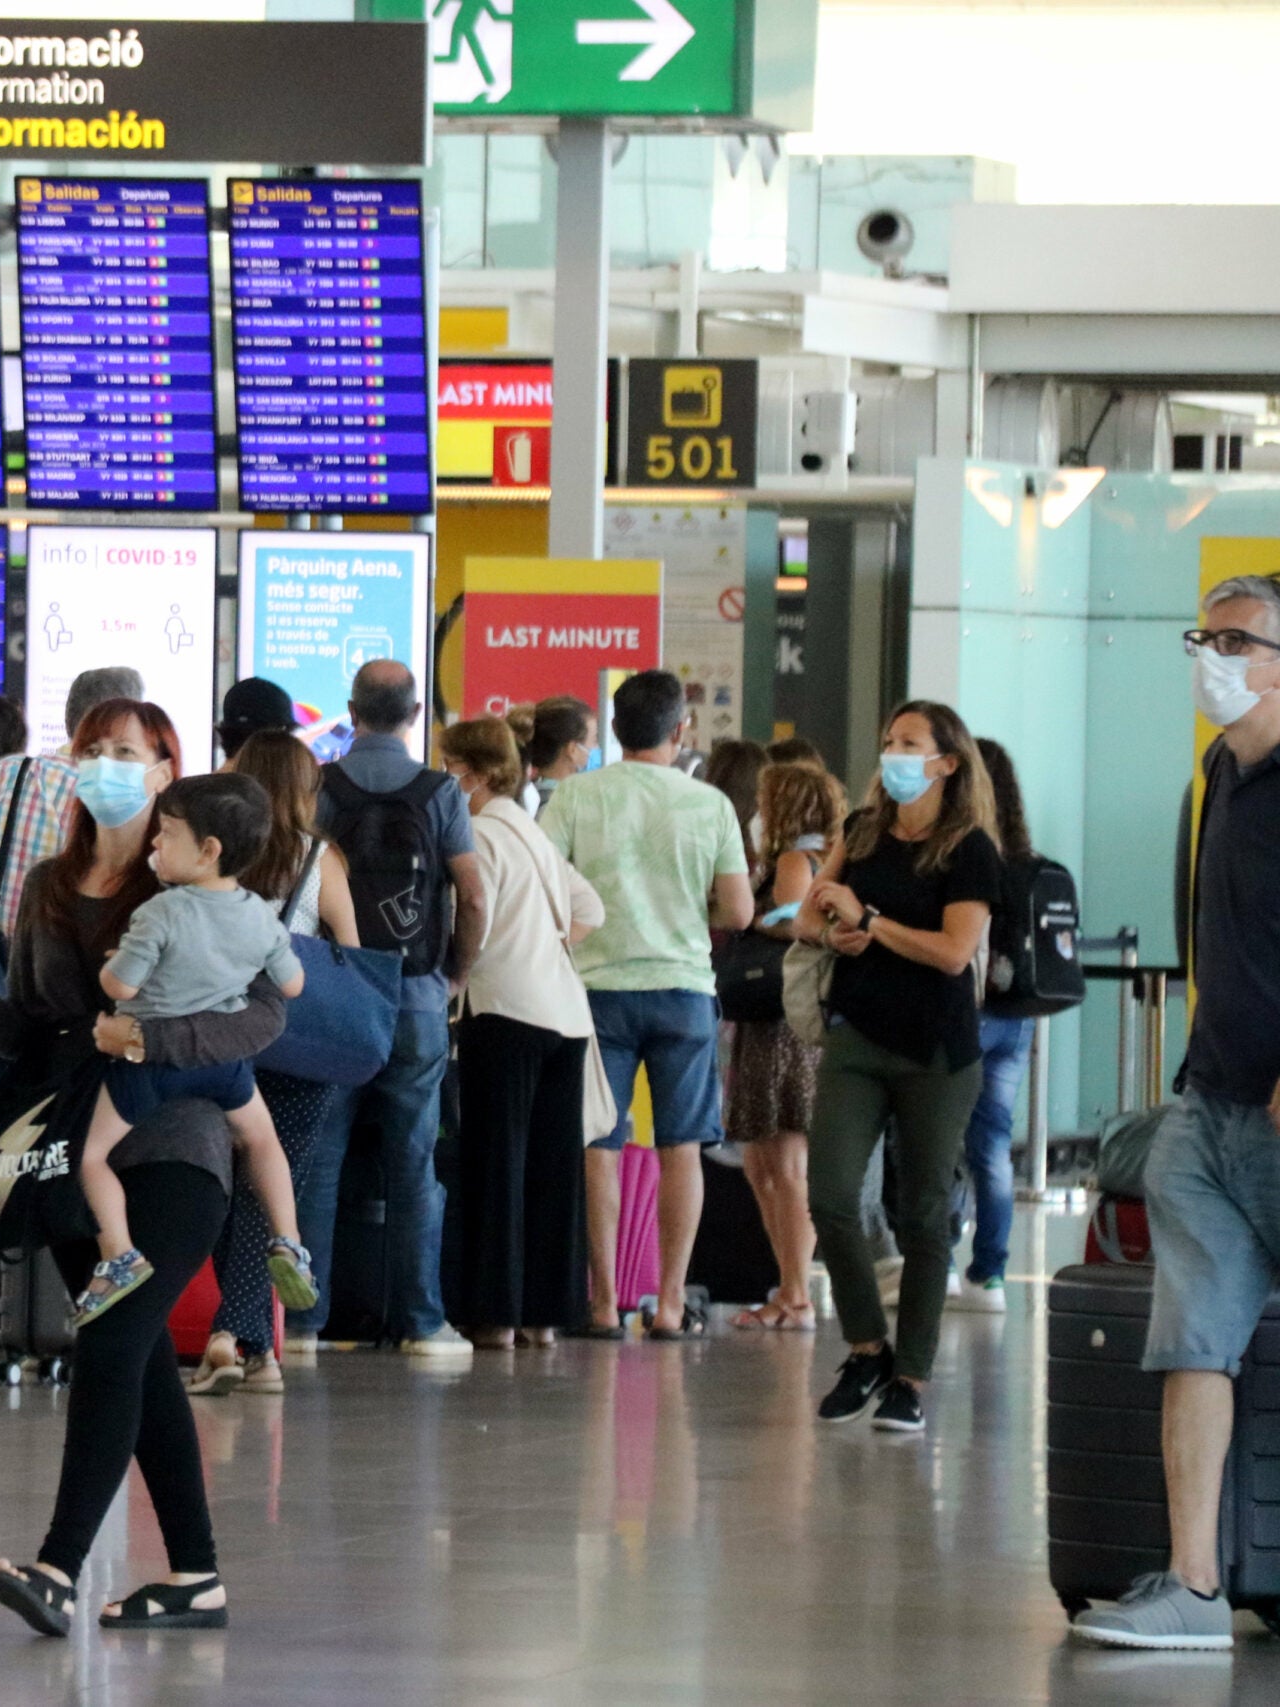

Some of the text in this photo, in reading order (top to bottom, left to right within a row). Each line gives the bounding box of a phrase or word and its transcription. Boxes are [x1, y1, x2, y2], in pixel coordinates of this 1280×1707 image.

[44, 185, 170, 200] Salidas Departures
[257, 188, 382, 202] Salidas Departures
[646, 437, 737, 480] 501
[43, 544, 197, 565] info COVID-19
[268, 556, 402, 580] Pàrquing Aena,
[267, 581, 364, 604] més segur.
[267, 601, 354, 613] Sense contacte
[279, 618, 292, 627] es
[295, 618, 338, 627] reserva
[276, 629, 311, 640] través
[314, 629, 329, 640] de
[486, 626, 640, 649] LAST MINUTE
[266, 643, 340, 657] la nostra app
[272, 657, 300, 669] web.
